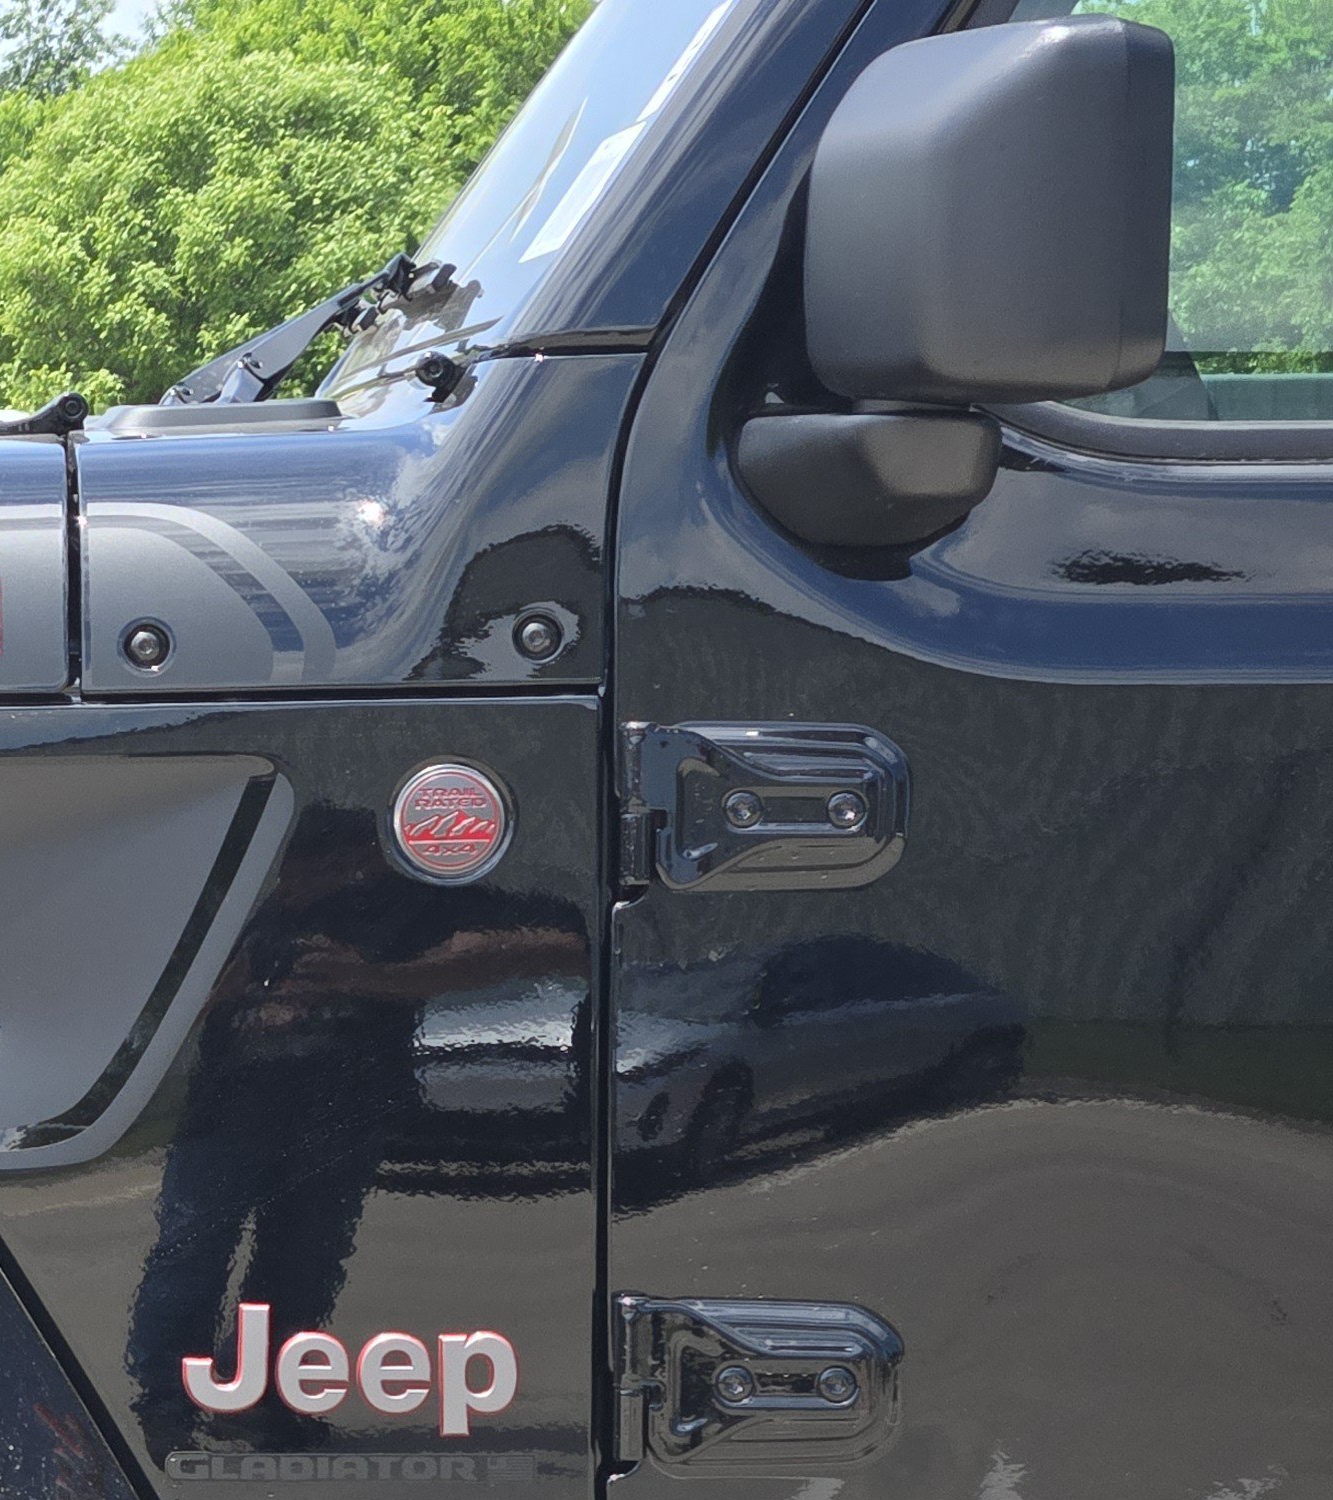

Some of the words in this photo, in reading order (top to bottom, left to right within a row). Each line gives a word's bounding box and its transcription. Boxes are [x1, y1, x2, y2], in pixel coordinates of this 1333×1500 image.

[414, 798, 487, 809] RATED
[418, 787, 482, 800] TRAIL
[181, 1302, 518, 1437] Jeep
[175, 1454, 478, 1482] GLADIATOR
